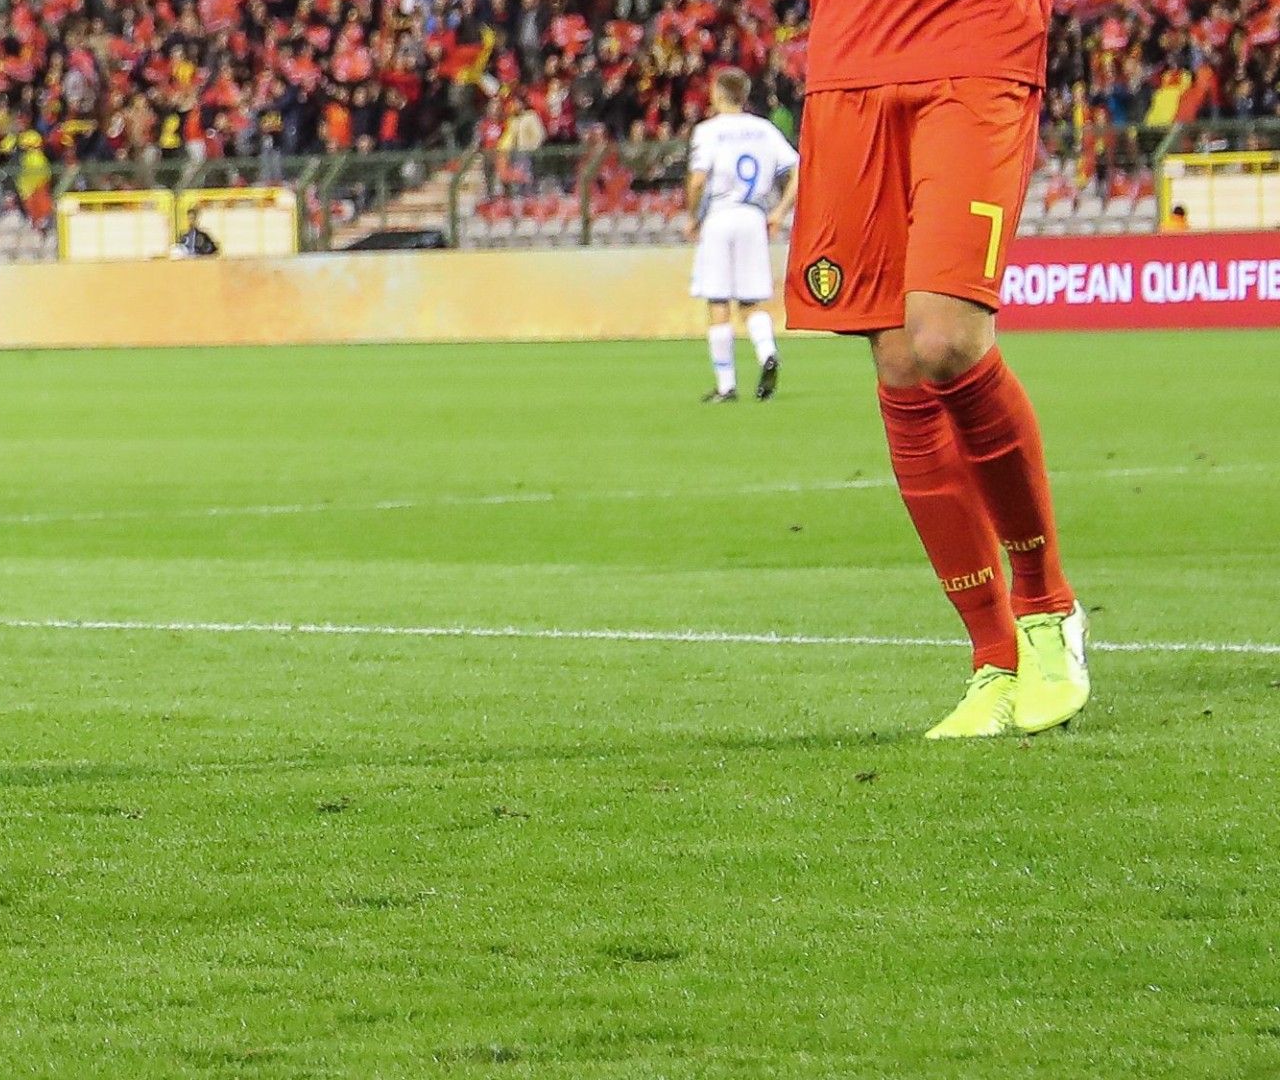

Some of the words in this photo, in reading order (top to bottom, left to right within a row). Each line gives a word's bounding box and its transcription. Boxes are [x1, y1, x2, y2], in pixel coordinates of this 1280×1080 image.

[736, 154, 759, 204] 9
[970, 201, 1004, 280] 7
[1141, 258, 1280, 303] QUALIFIE
